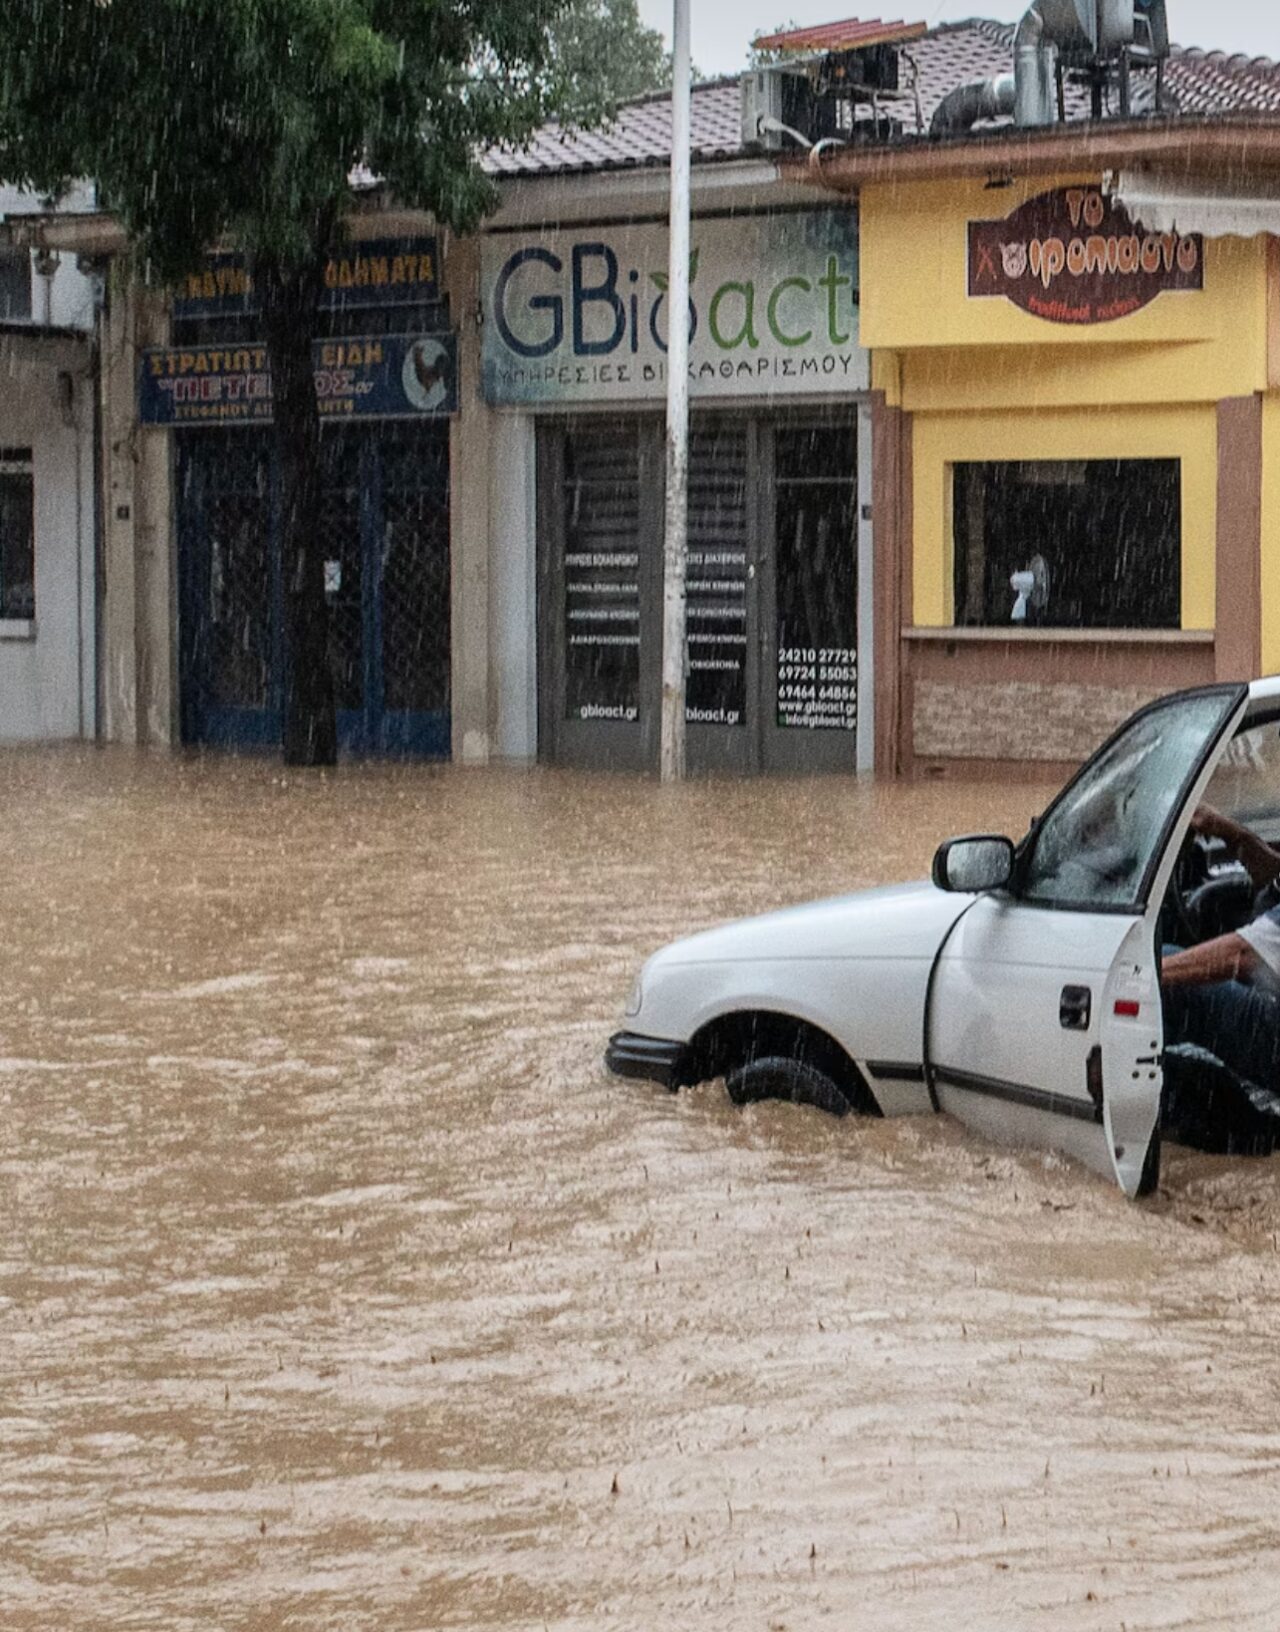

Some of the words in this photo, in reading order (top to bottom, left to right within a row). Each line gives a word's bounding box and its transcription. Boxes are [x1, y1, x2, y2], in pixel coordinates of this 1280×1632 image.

[778, 648, 816, 663] 24210
[819, 648, 857, 663] 27729
[778, 665, 816, 681] 69724
